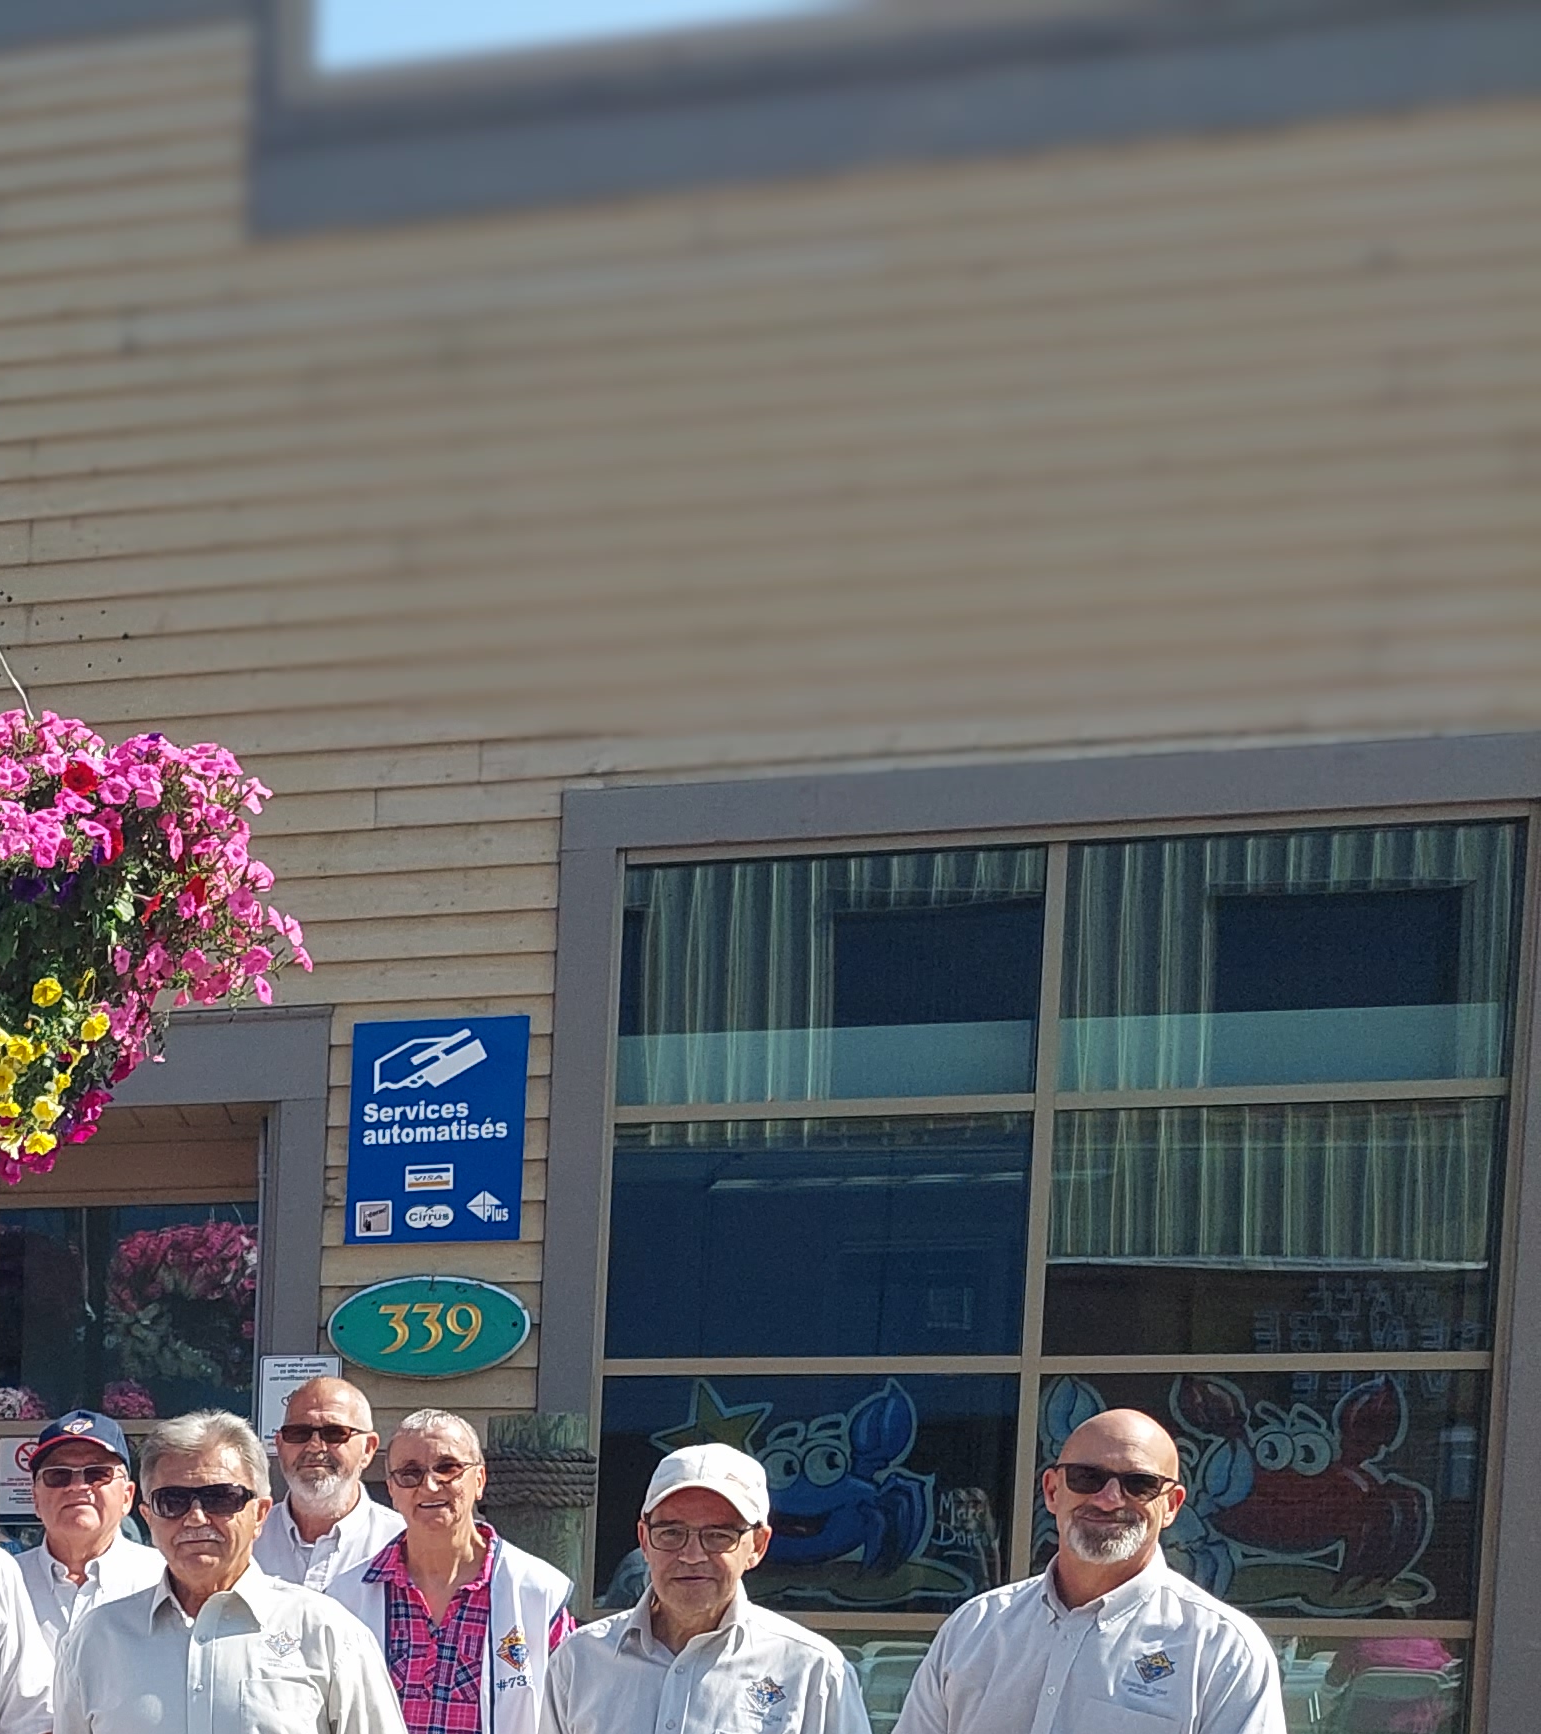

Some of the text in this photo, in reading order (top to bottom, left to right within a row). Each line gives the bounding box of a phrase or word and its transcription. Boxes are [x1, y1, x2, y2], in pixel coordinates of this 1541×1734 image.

[363, 1099, 469, 1122] Services
[362, 1118, 508, 1146] automatisés
[413, 1174, 444, 1182] VISA
[408, 1210, 450, 1223] Cirrus
[484, 1203, 509, 1223] Plus
[378, 1302, 483, 1355] 339
